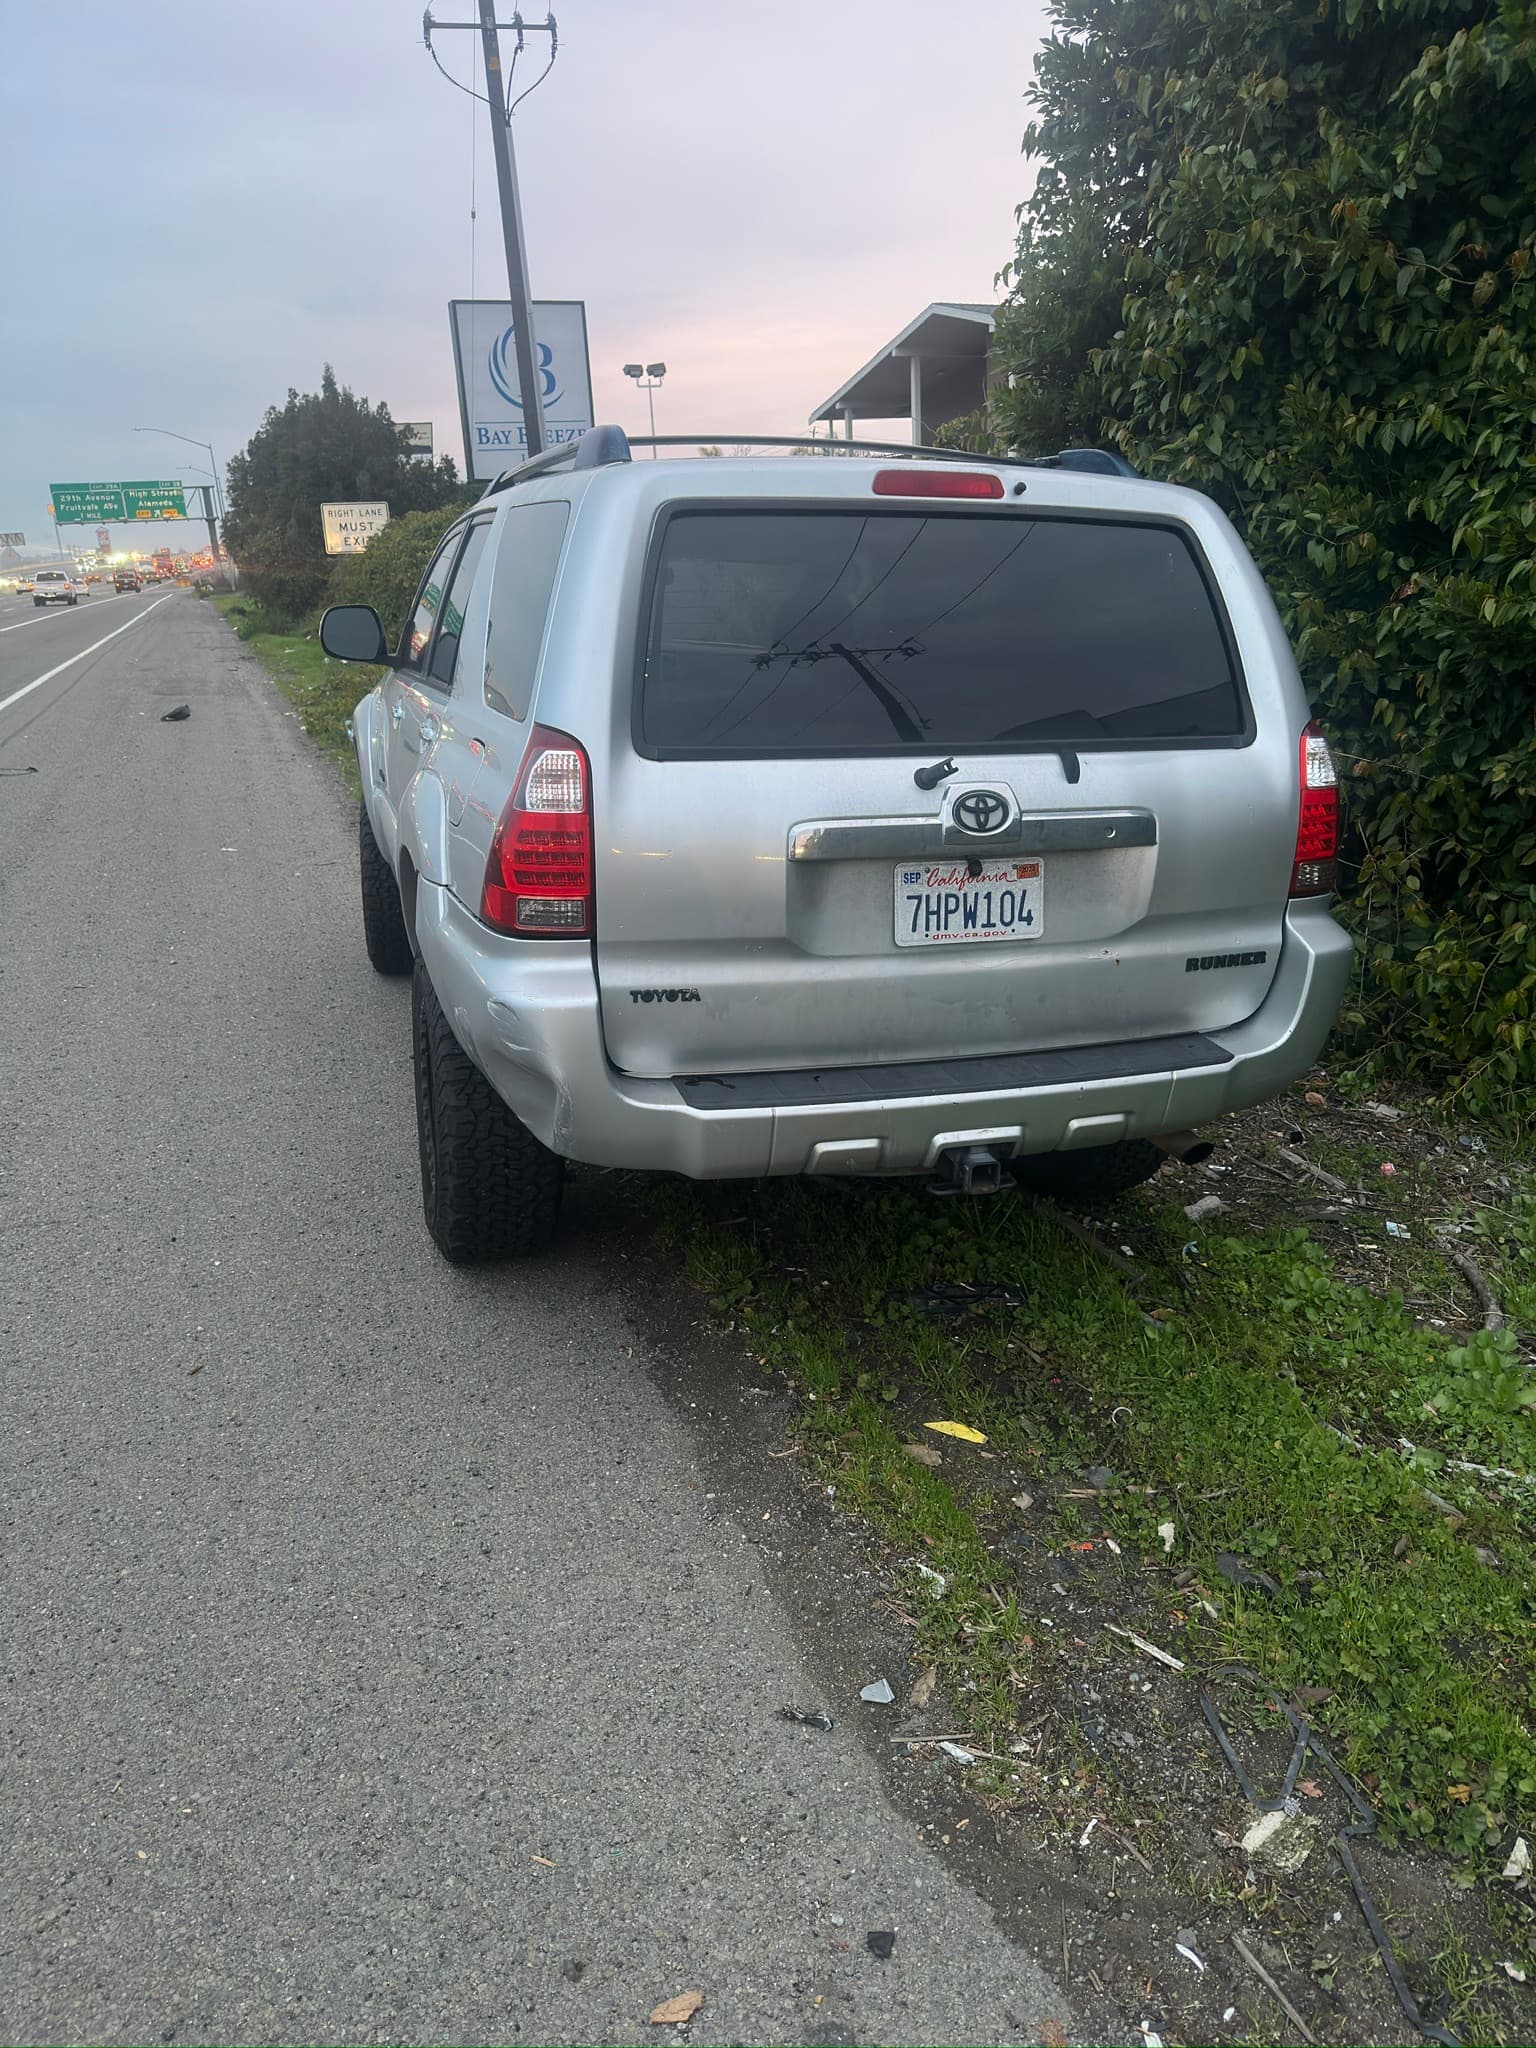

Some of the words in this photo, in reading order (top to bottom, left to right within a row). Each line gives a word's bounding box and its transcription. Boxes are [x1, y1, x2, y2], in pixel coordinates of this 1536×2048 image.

[476, 427, 512, 445] BAY
[60, 494, 82, 502] 29th
[85, 494, 115, 502] Avenue
[129, 489, 148, 498] High
[151, 489, 177, 497] Street
[60, 503, 99, 511] Fruitvale
[327, 509, 355, 518] RIGHT
[359, 508, 384, 517] LANE
[339, 521, 374, 532] MUST
[344, 536, 369, 546] EXI
[903, 872, 921, 884] SEP
[926, 867, 1017, 891] California
[906, 888, 1034, 933] 7HPW104
[932, 930, 1008, 940] dmv.ca.gov
[1185, 951, 1267, 973] RUNNER
[629, 988, 702, 1004] TOYOTA
